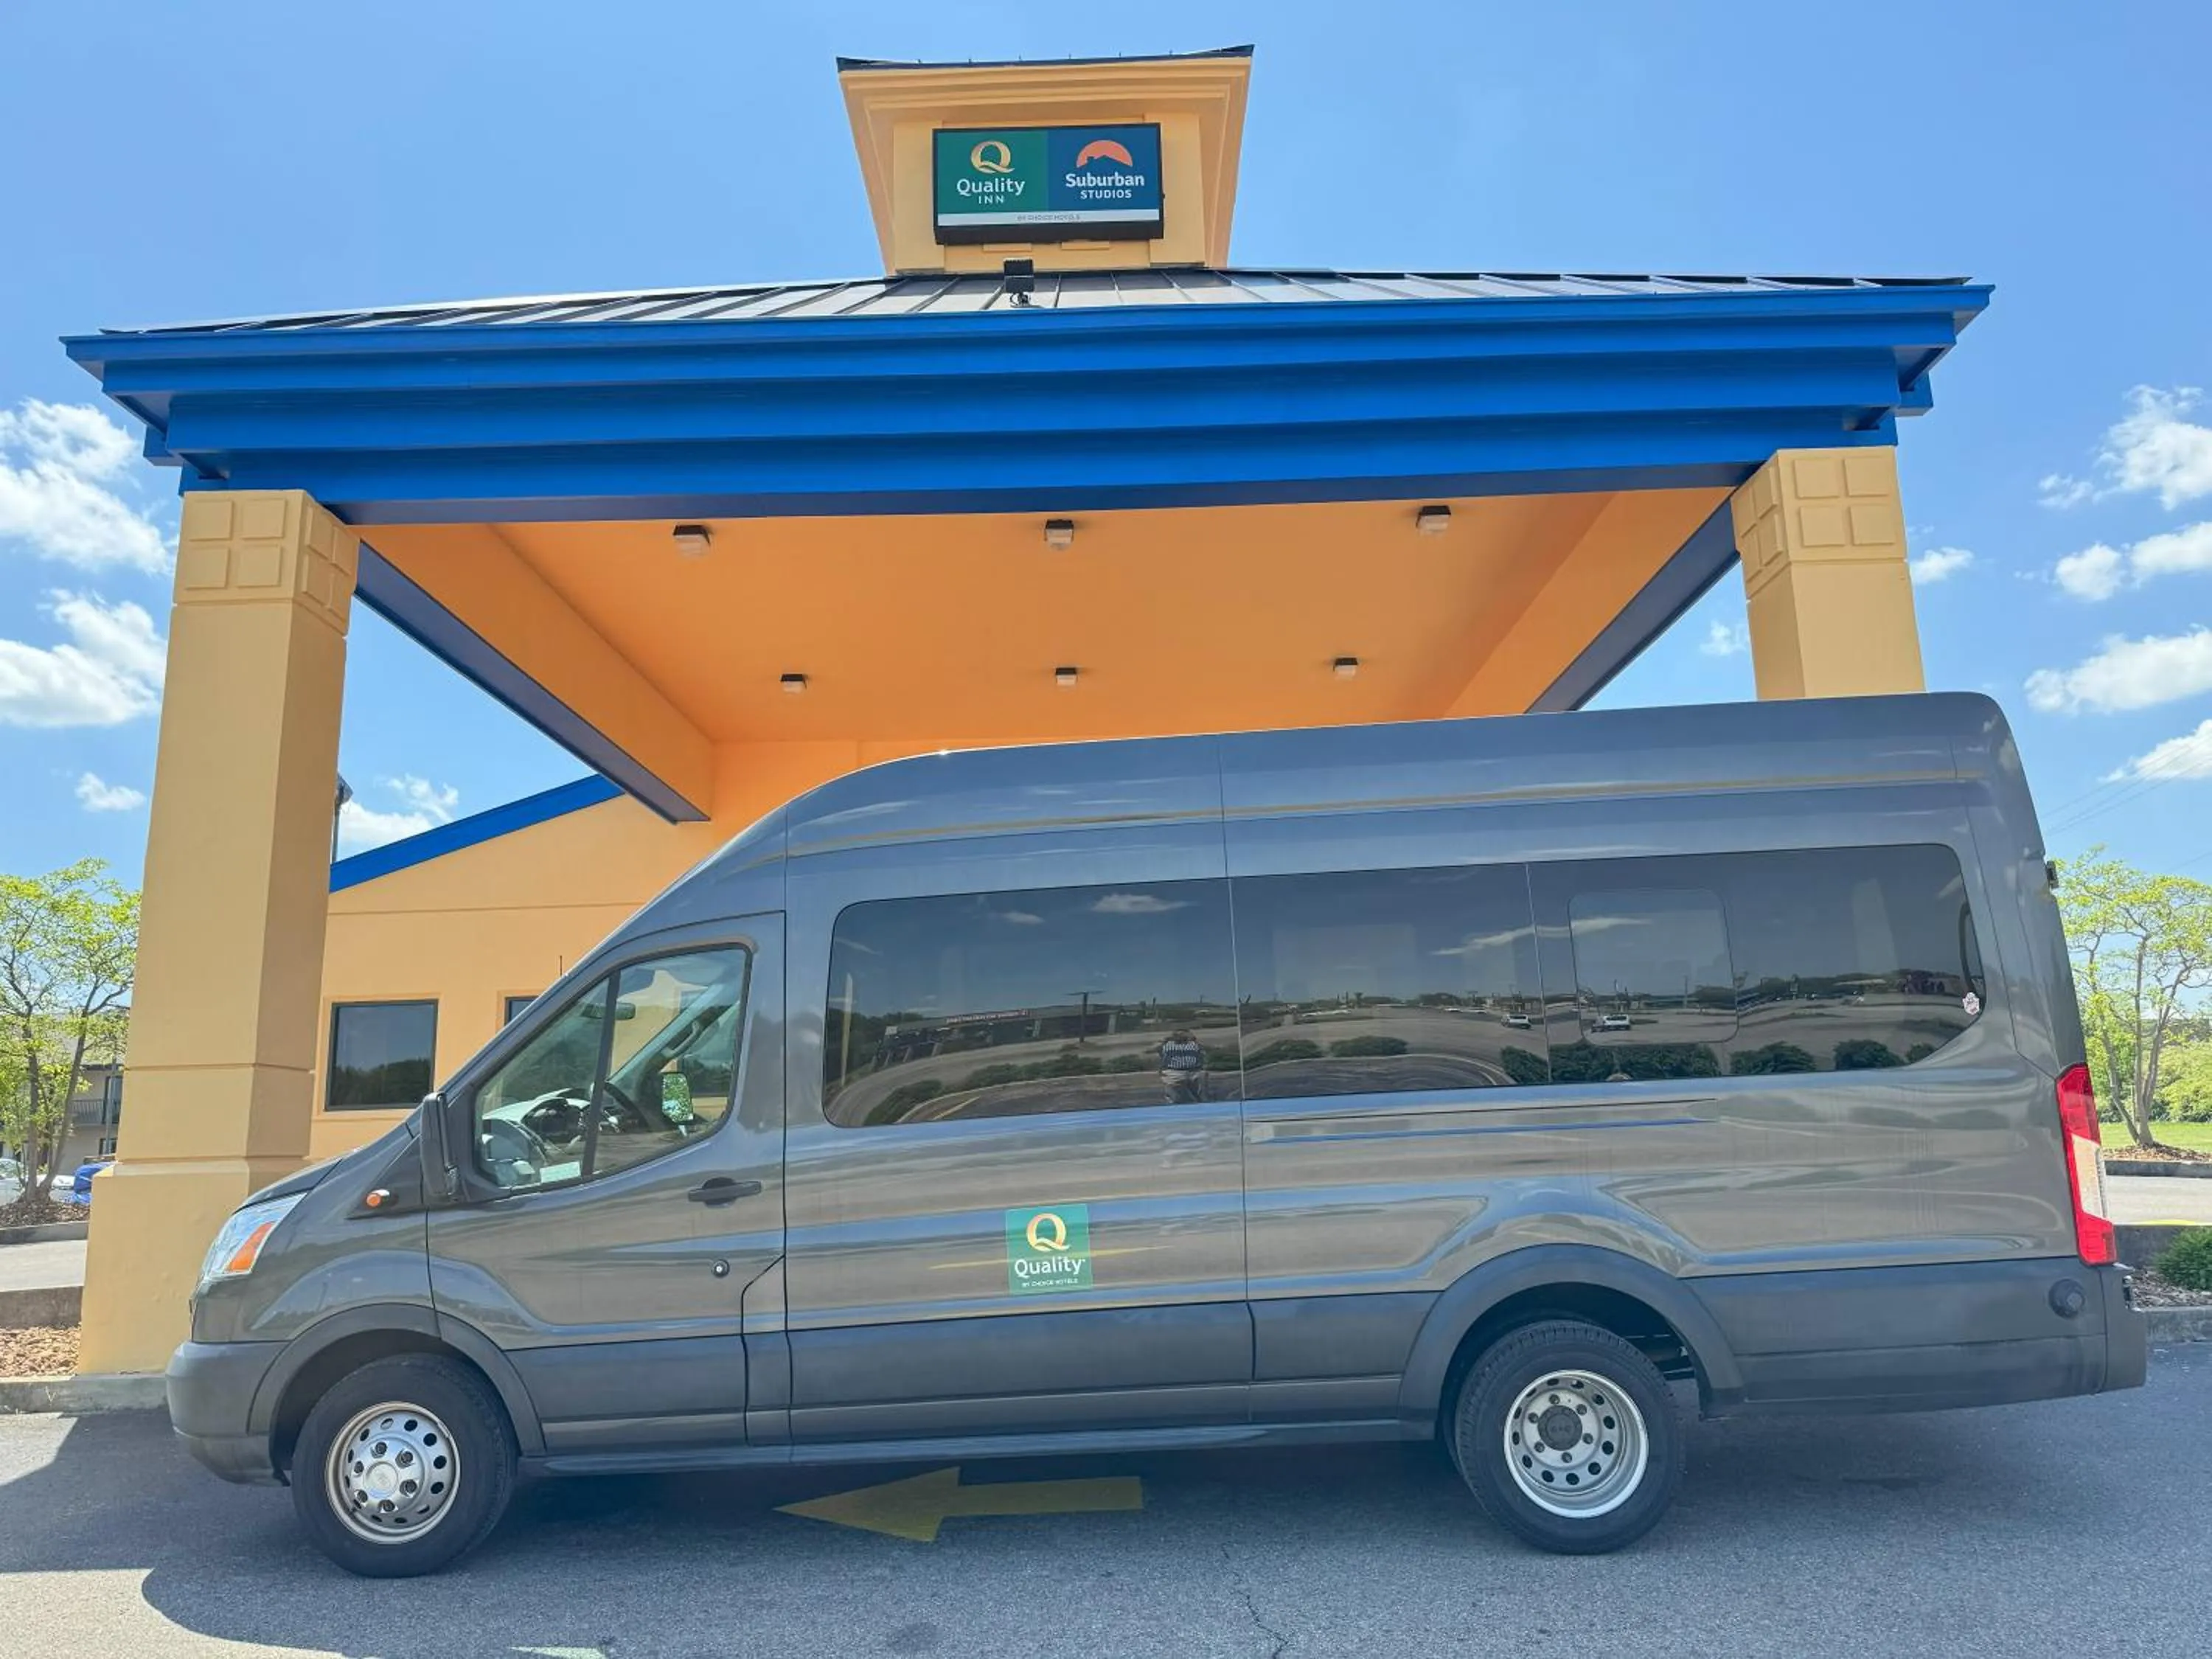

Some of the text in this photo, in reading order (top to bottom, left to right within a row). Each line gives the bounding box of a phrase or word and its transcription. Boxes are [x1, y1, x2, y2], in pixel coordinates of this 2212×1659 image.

[970, 141, 1015, 173] Q
[956, 178, 1025, 197] Quality
[1065, 171, 1144, 187] Suburban
[978, 195, 1004, 204] INN
[1080, 189, 1132, 199] STUDIOS
[1027, 1213, 1071, 1251] Q
[1015, 1256, 1083, 1279] Quality
